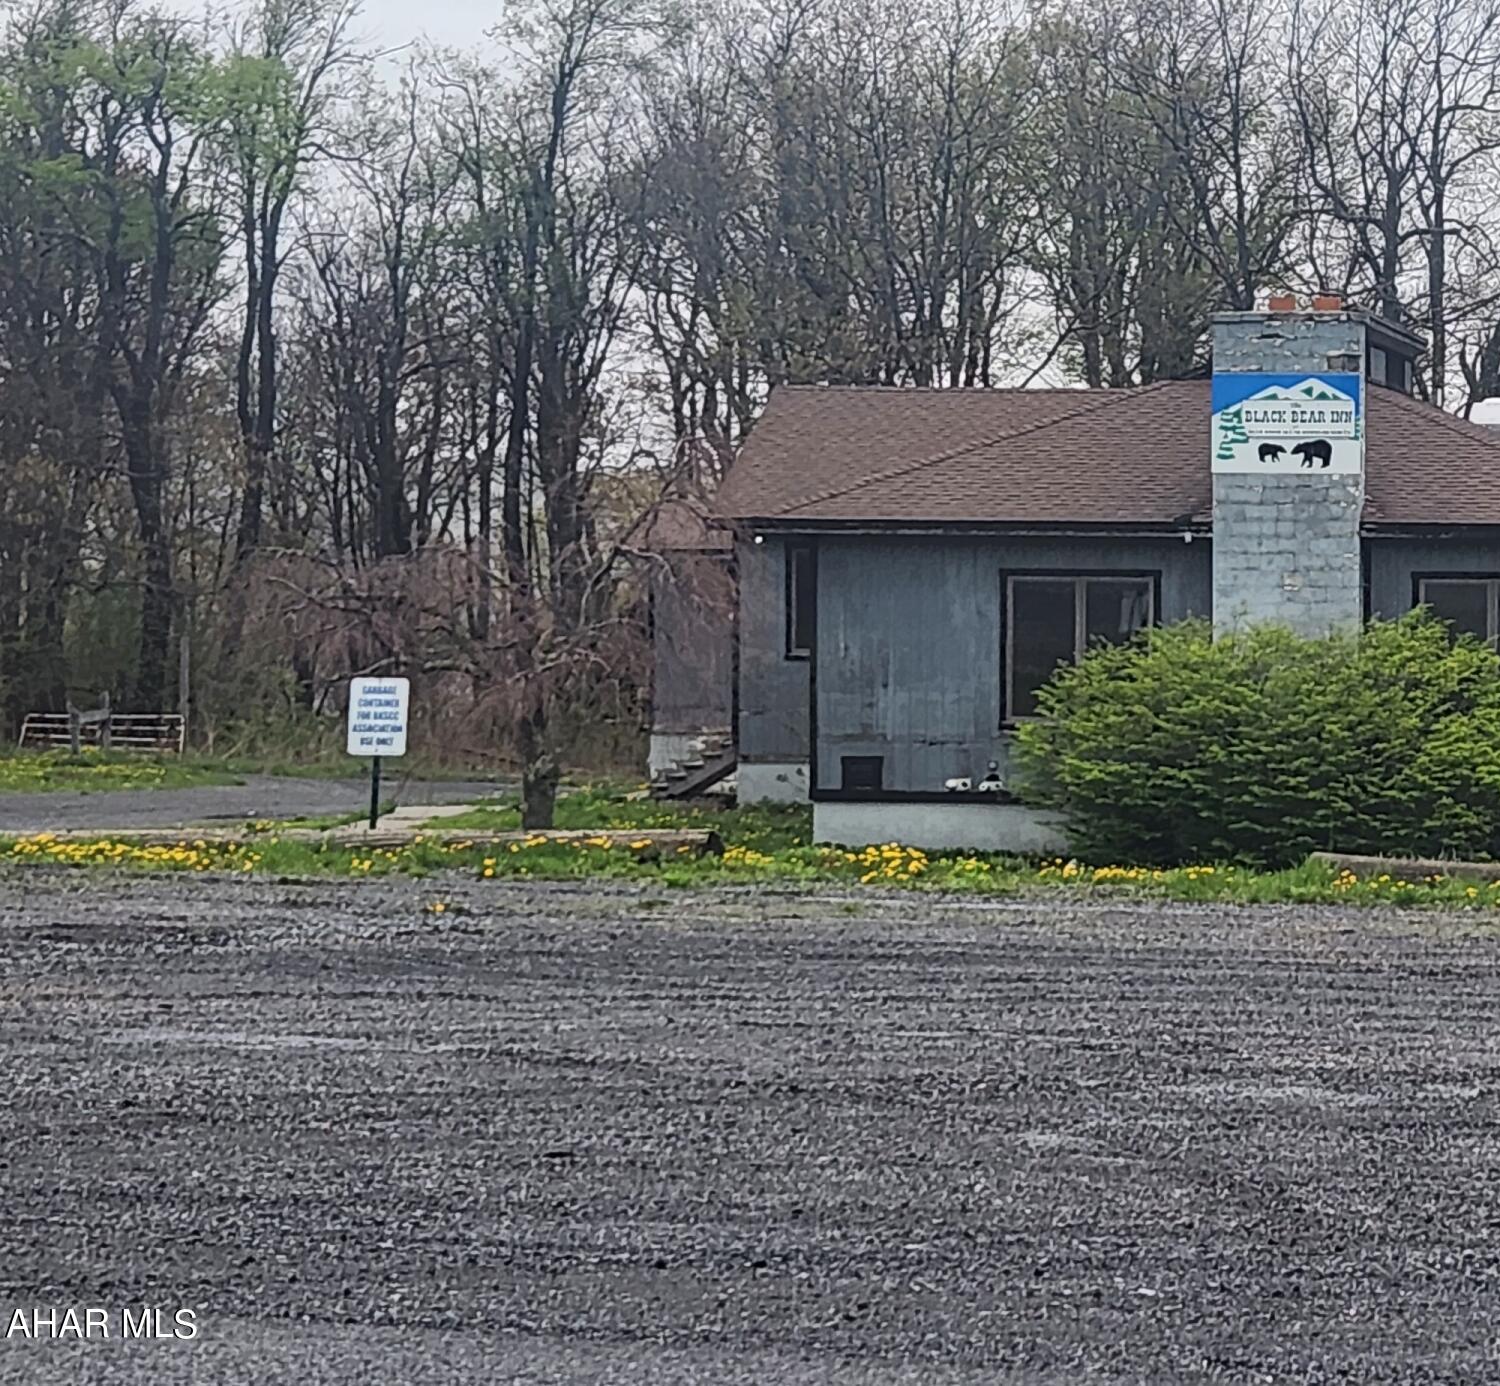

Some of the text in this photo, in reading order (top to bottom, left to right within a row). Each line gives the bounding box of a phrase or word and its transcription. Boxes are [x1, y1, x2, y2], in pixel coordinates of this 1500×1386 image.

[1244, 410, 1353, 424] BLACK BEAR INN
[357, 698, 400, 708] CONTAINER
[351, 723, 403, 733] ASSOCIATION
